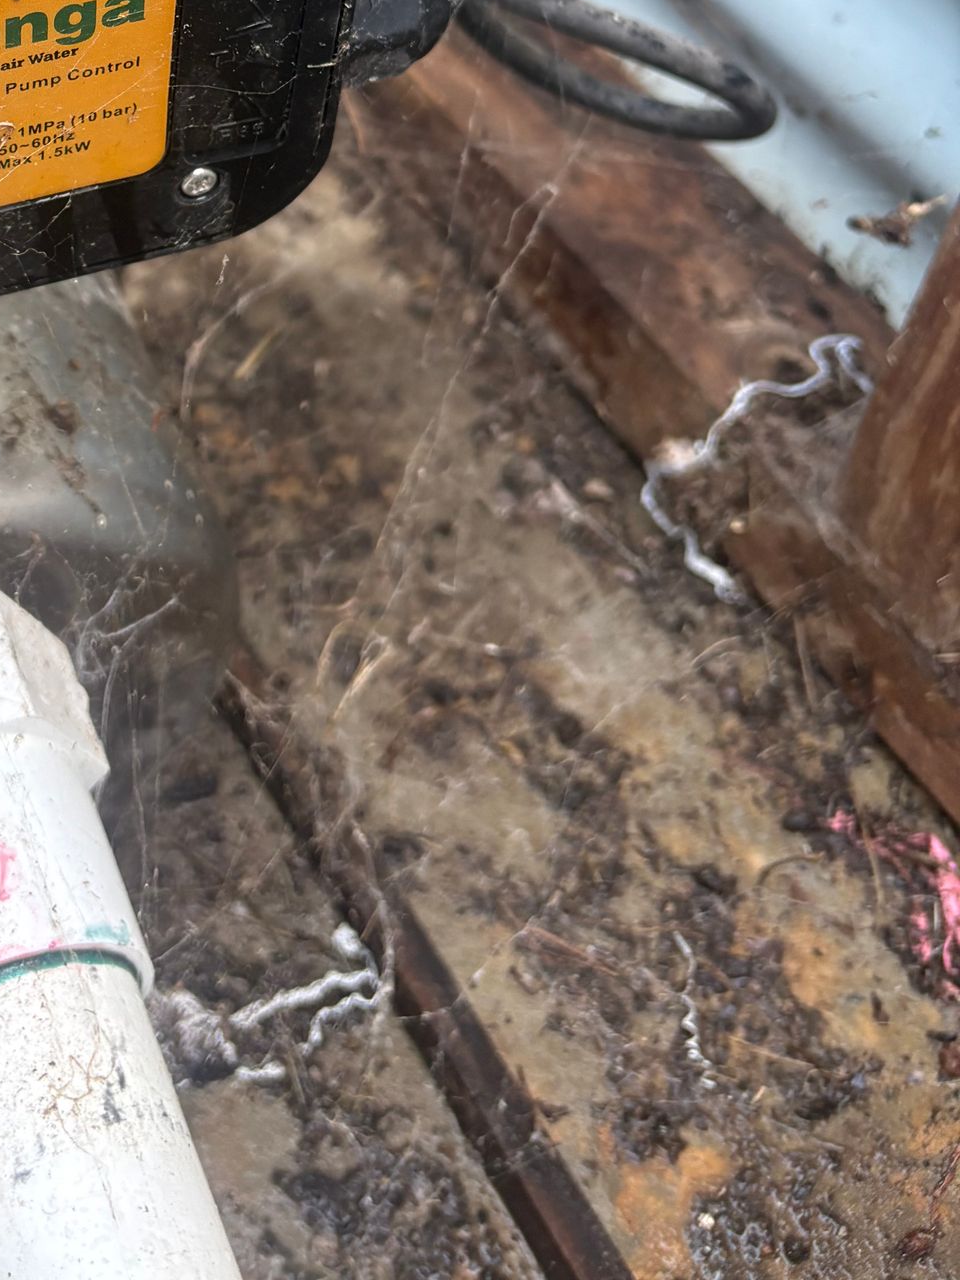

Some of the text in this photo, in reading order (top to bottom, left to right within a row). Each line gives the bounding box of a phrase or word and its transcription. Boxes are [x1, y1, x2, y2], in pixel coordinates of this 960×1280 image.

[27, 47, 80, 65] Water
[5, 76, 62, 96] Pump
[67, 56, 141, 82] Control
[18, 120, 66, 138] 1MPa
[71, 112, 98, 128] (10
[102, 102, 138, 120] bar)
[39, 139, 92, 161] 1.5kW
